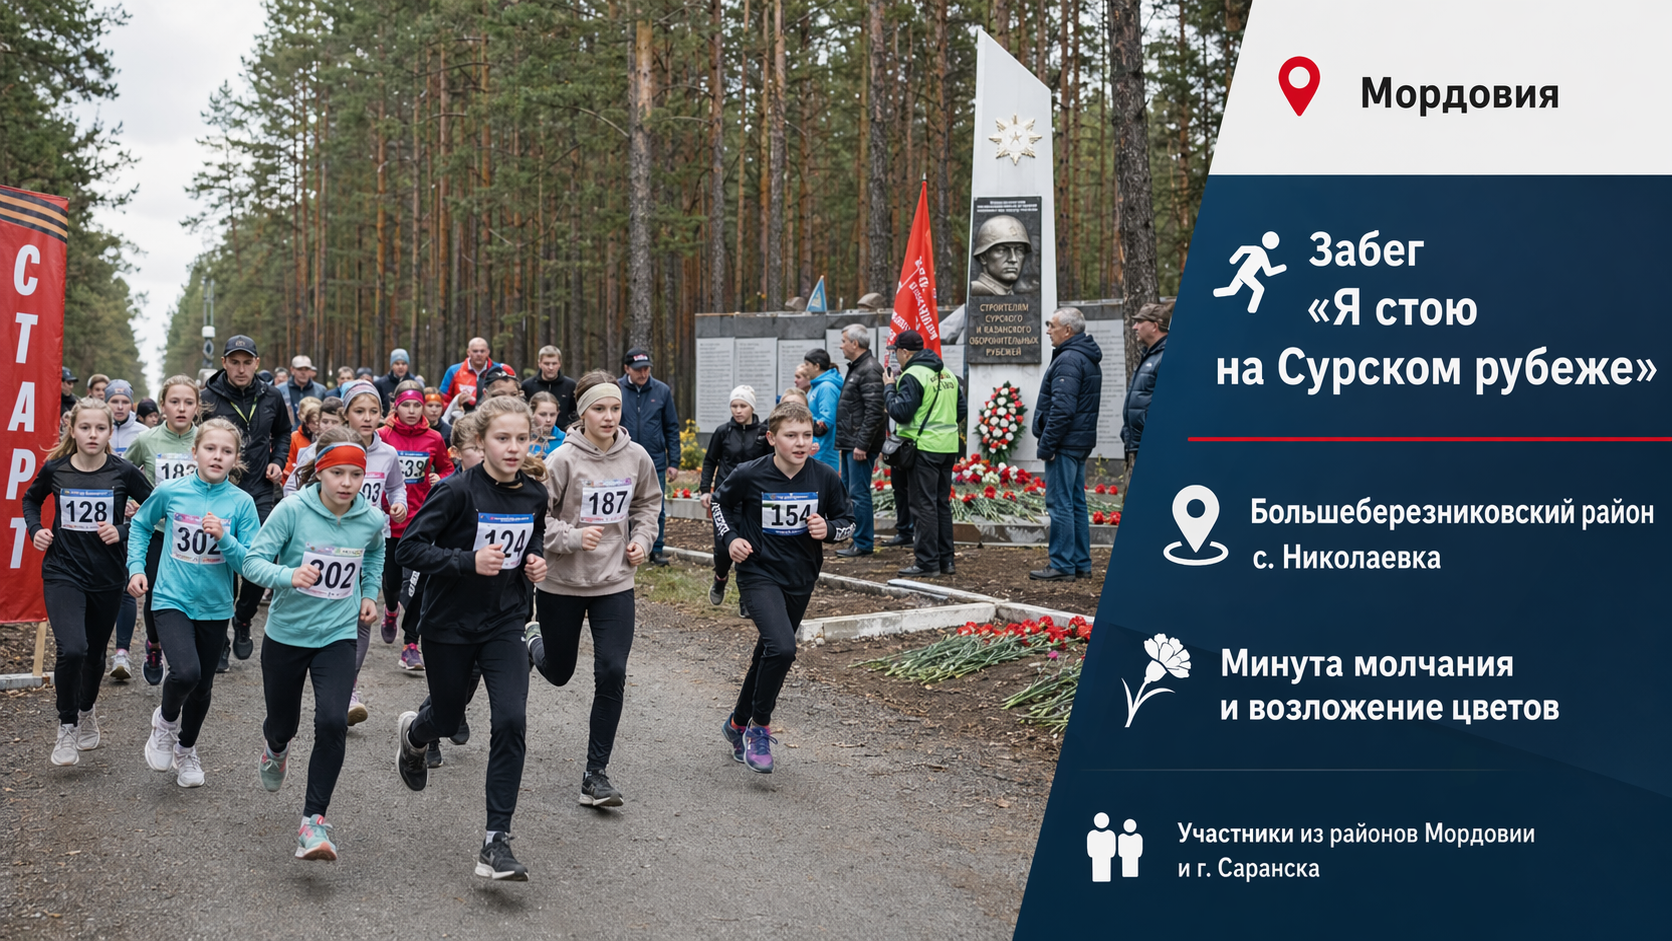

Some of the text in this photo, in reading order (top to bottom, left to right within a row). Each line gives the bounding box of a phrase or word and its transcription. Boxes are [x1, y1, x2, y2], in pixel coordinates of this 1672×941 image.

[976, 325, 982, 334] И
[6, 244, 41, 569] СТАРТ
[400, 459, 424, 478] 39
[66, 500, 107, 522] 128
[589, 490, 628, 515] 187
[771, 504, 811, 526] 154
[177, 527, 221, 555] 302
[484, 529, 526, 558] 124
